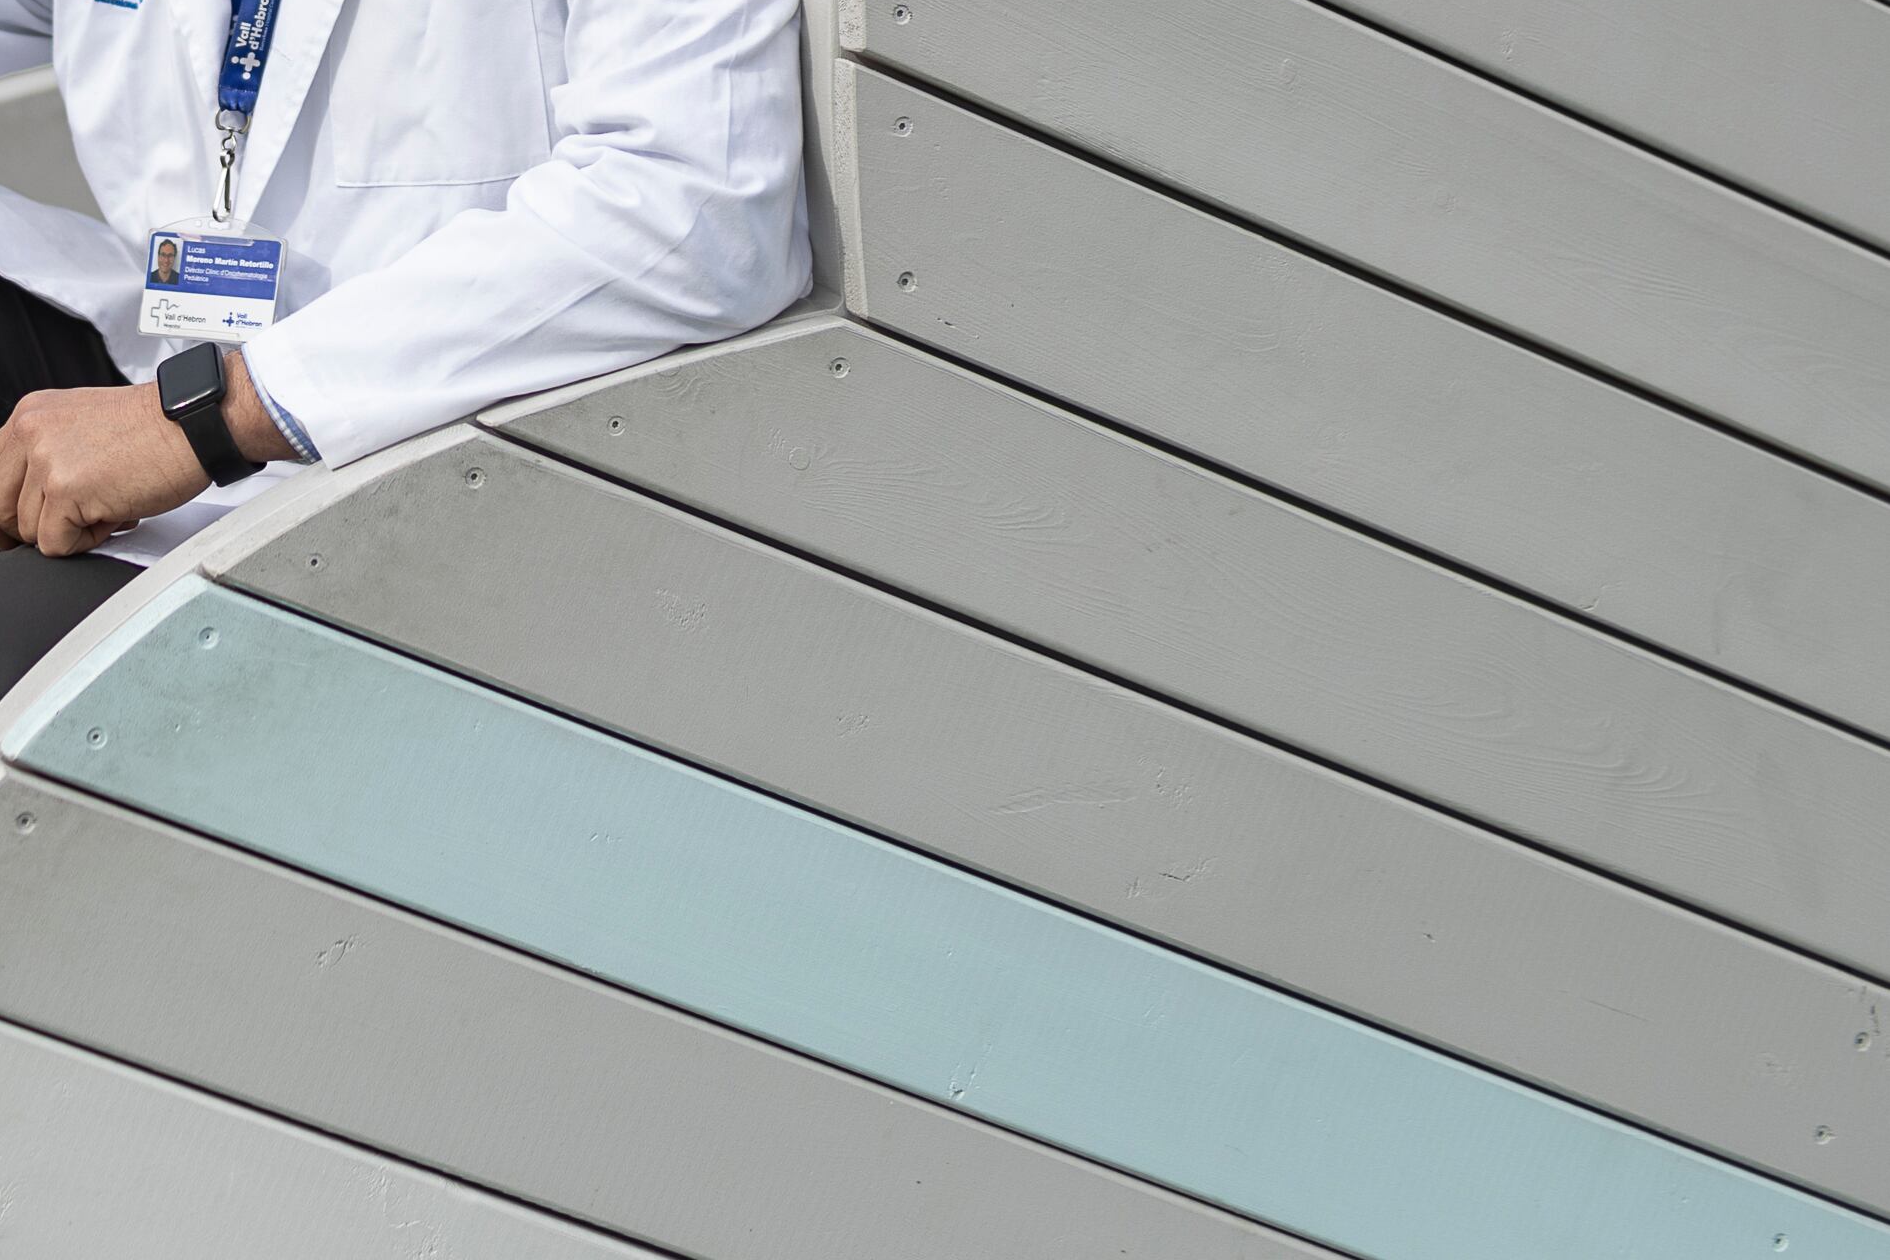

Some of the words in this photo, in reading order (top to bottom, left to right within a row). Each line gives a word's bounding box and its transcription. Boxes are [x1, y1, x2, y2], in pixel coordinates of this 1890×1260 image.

[235, 21, 252, 48] Vall
[187, 246, 206, 254] Lucas
[186, 255, 213, 264] Moreno
[239, 259, 274, 269] Retortillo
[164, 312, 176, 321] Vall
[177, 315, 207, 324] d'Hebron
